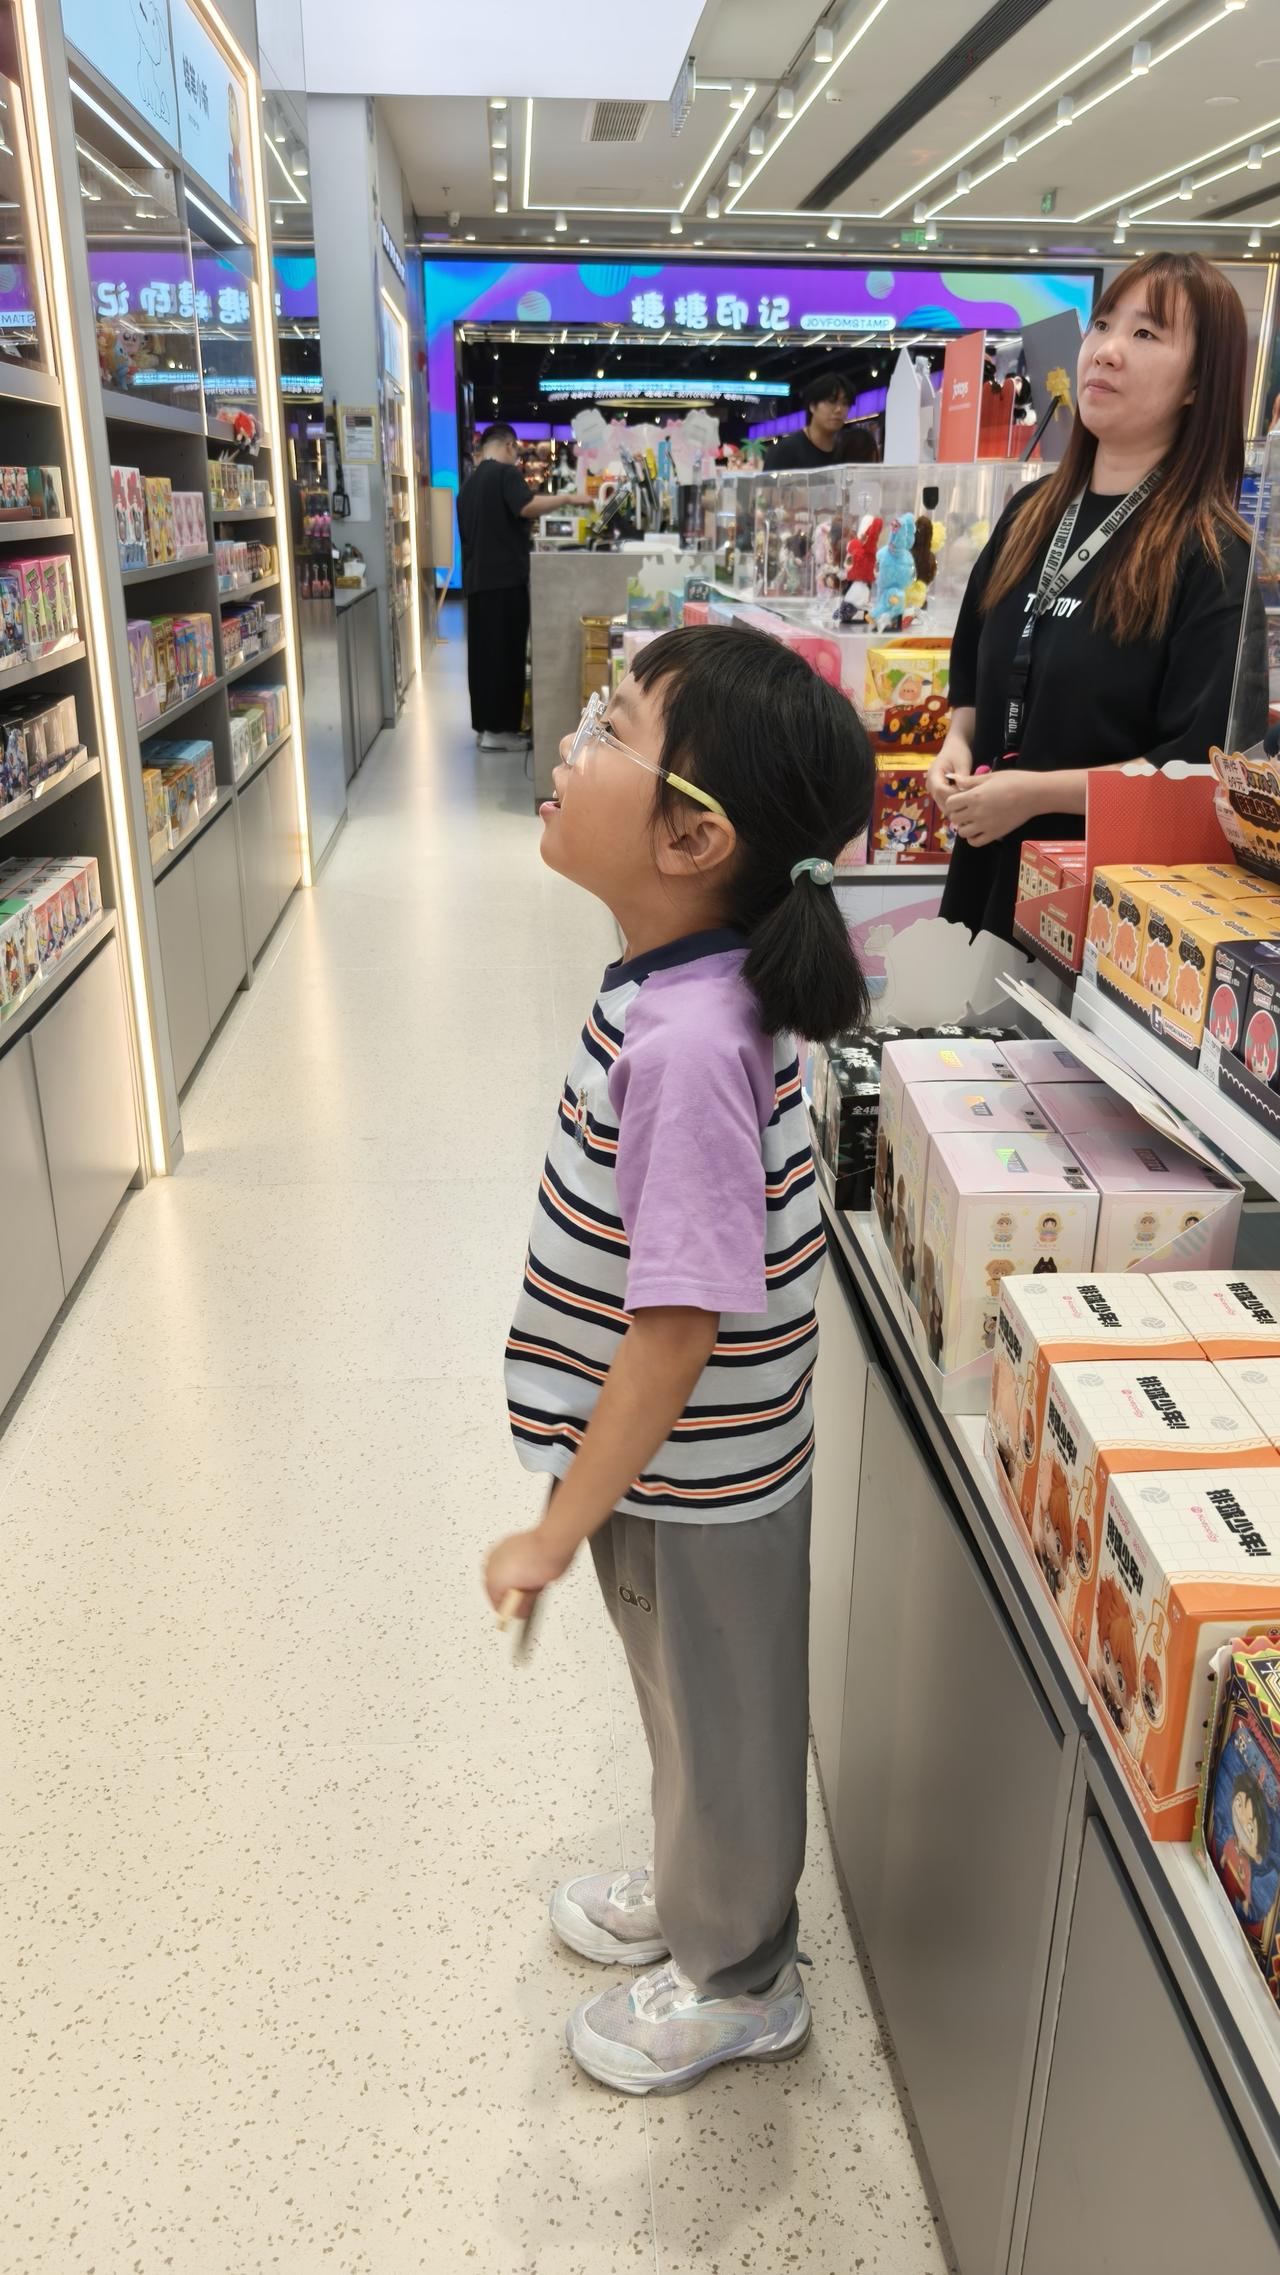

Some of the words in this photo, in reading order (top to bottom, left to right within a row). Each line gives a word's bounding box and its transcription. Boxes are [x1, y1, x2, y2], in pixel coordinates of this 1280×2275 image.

[631, 292, 790, 330] 糖糖印记
[1046, 549, 1063, 573] TOYS
[1052, 597, 1082, 618] TOY
[1009, 702, 1019, 718] TOY
[1009, 718, 1018, 734] TOP
[1206, 1488, 1272, 1557] 排球少年!!
